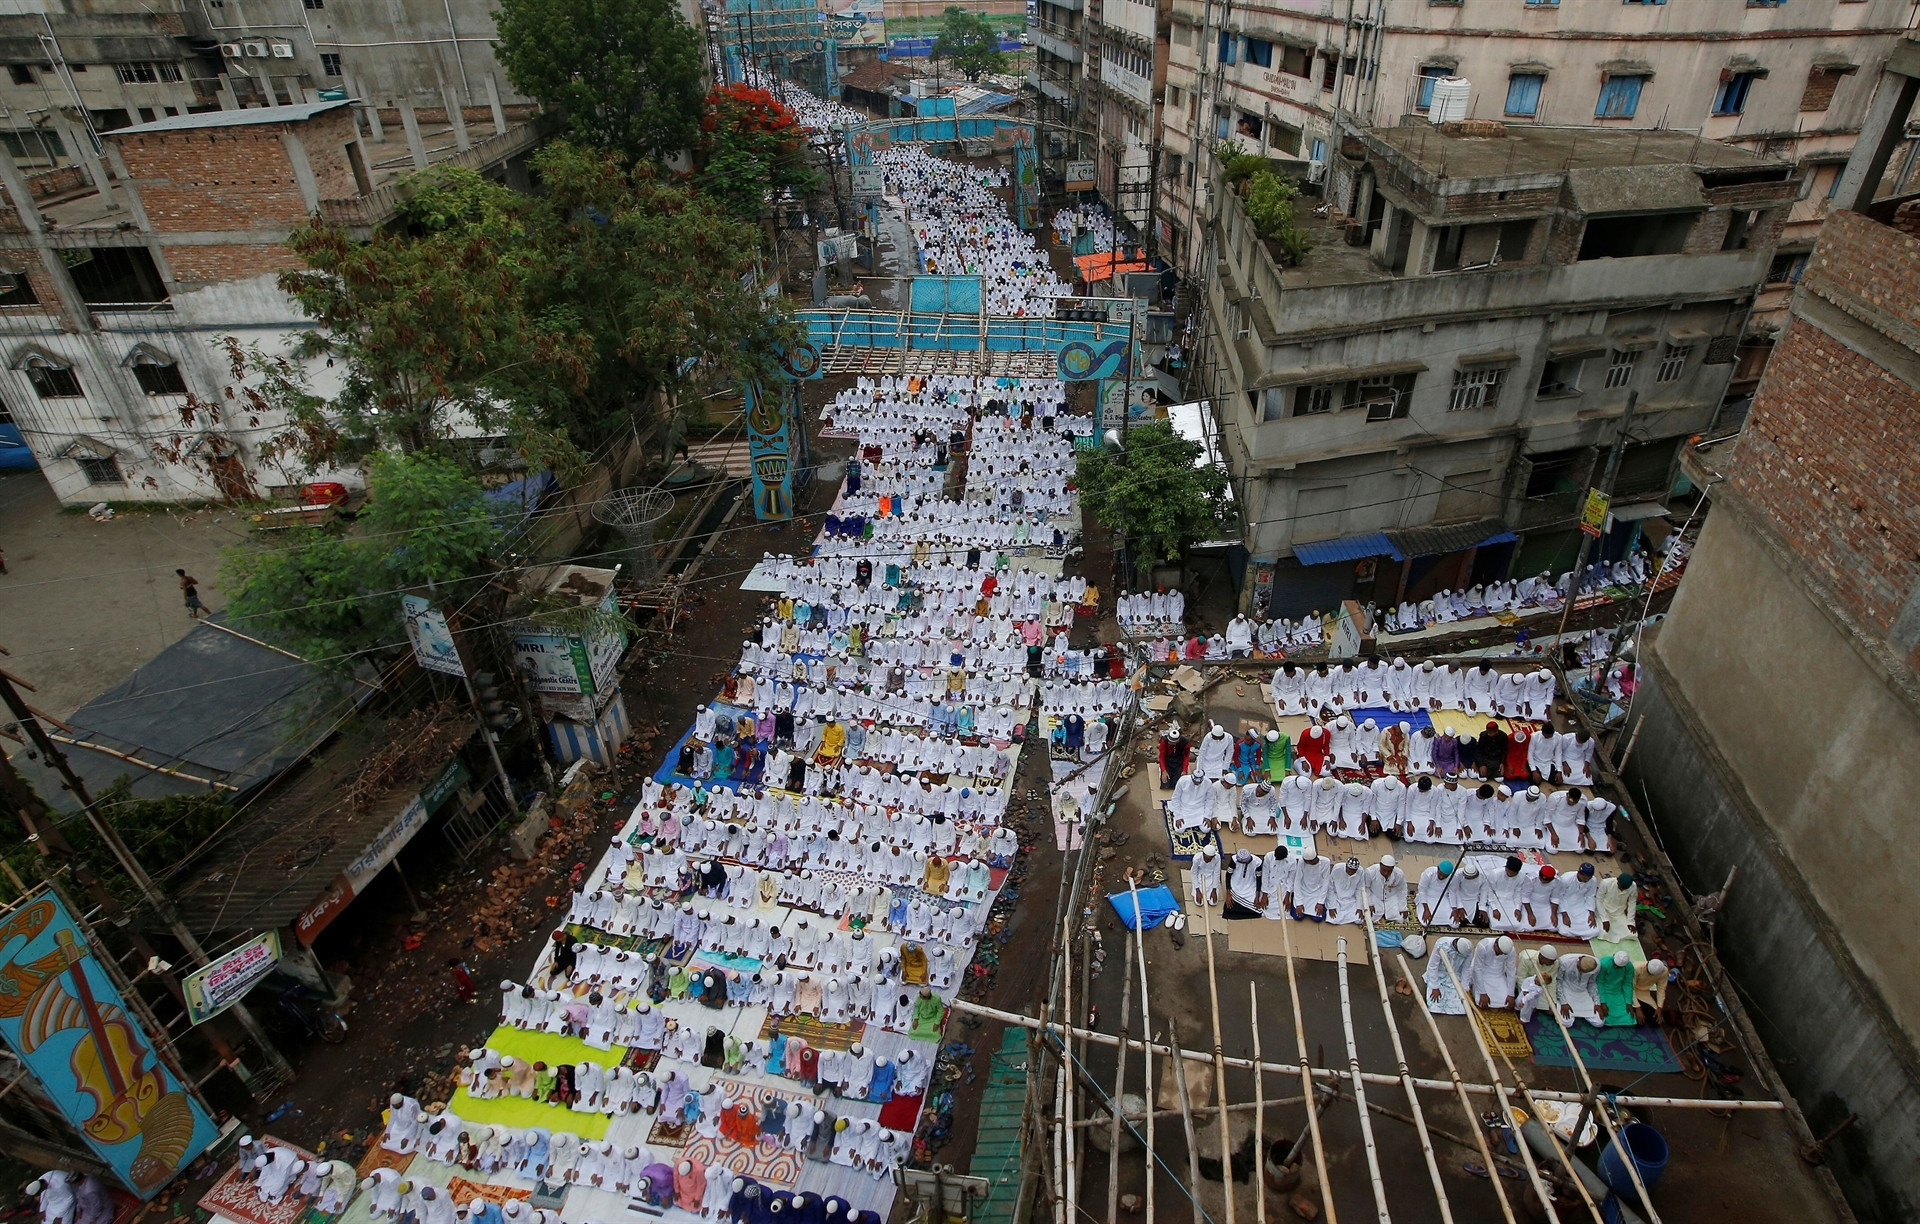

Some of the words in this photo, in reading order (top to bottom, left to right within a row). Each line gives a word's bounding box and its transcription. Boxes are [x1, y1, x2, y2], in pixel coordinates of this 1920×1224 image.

[1067, 351, 1090, 370] Ma
[517, 643, 546, 653] MRI
[558, 677, 578, 685] Centre
